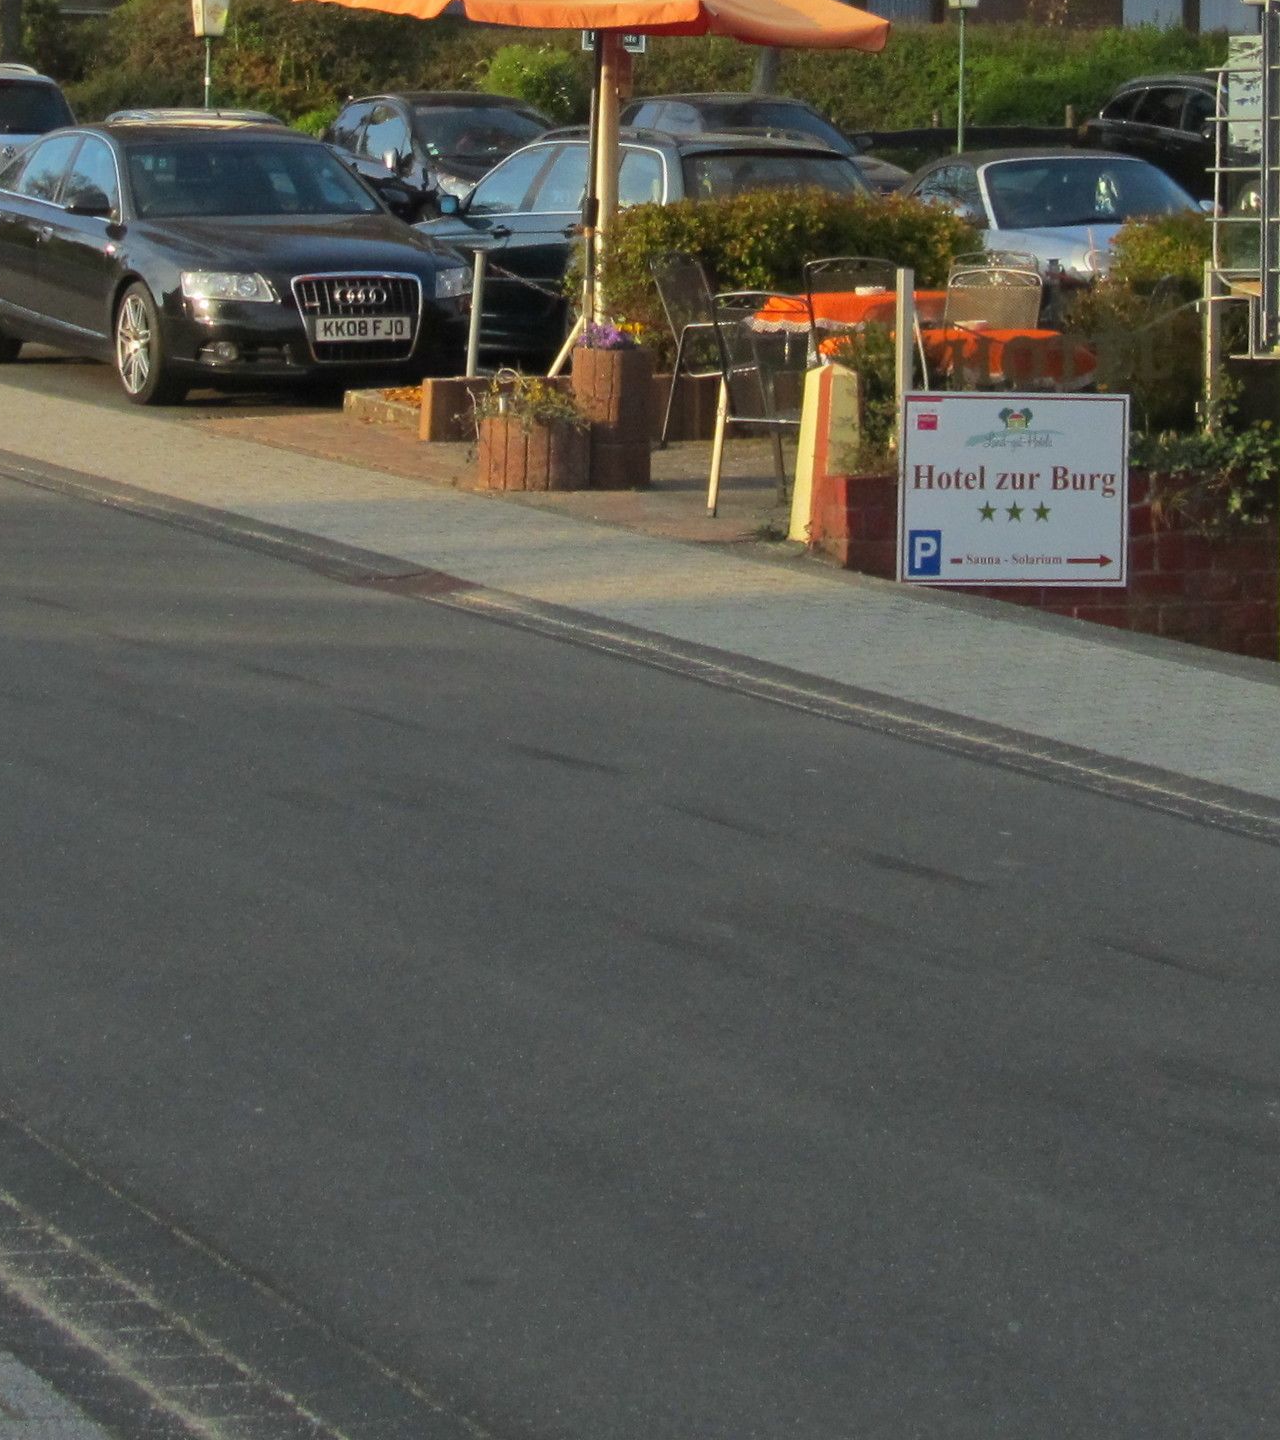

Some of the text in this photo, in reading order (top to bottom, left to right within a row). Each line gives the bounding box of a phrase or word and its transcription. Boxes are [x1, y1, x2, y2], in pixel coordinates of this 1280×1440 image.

[323, 320, 368, 336] KK08
[913, 464, 1117, 498] Hotel zur Burg
[966, 553, 1001, 564] Sauna
[1012, 553, 1063, 564] Solarium
